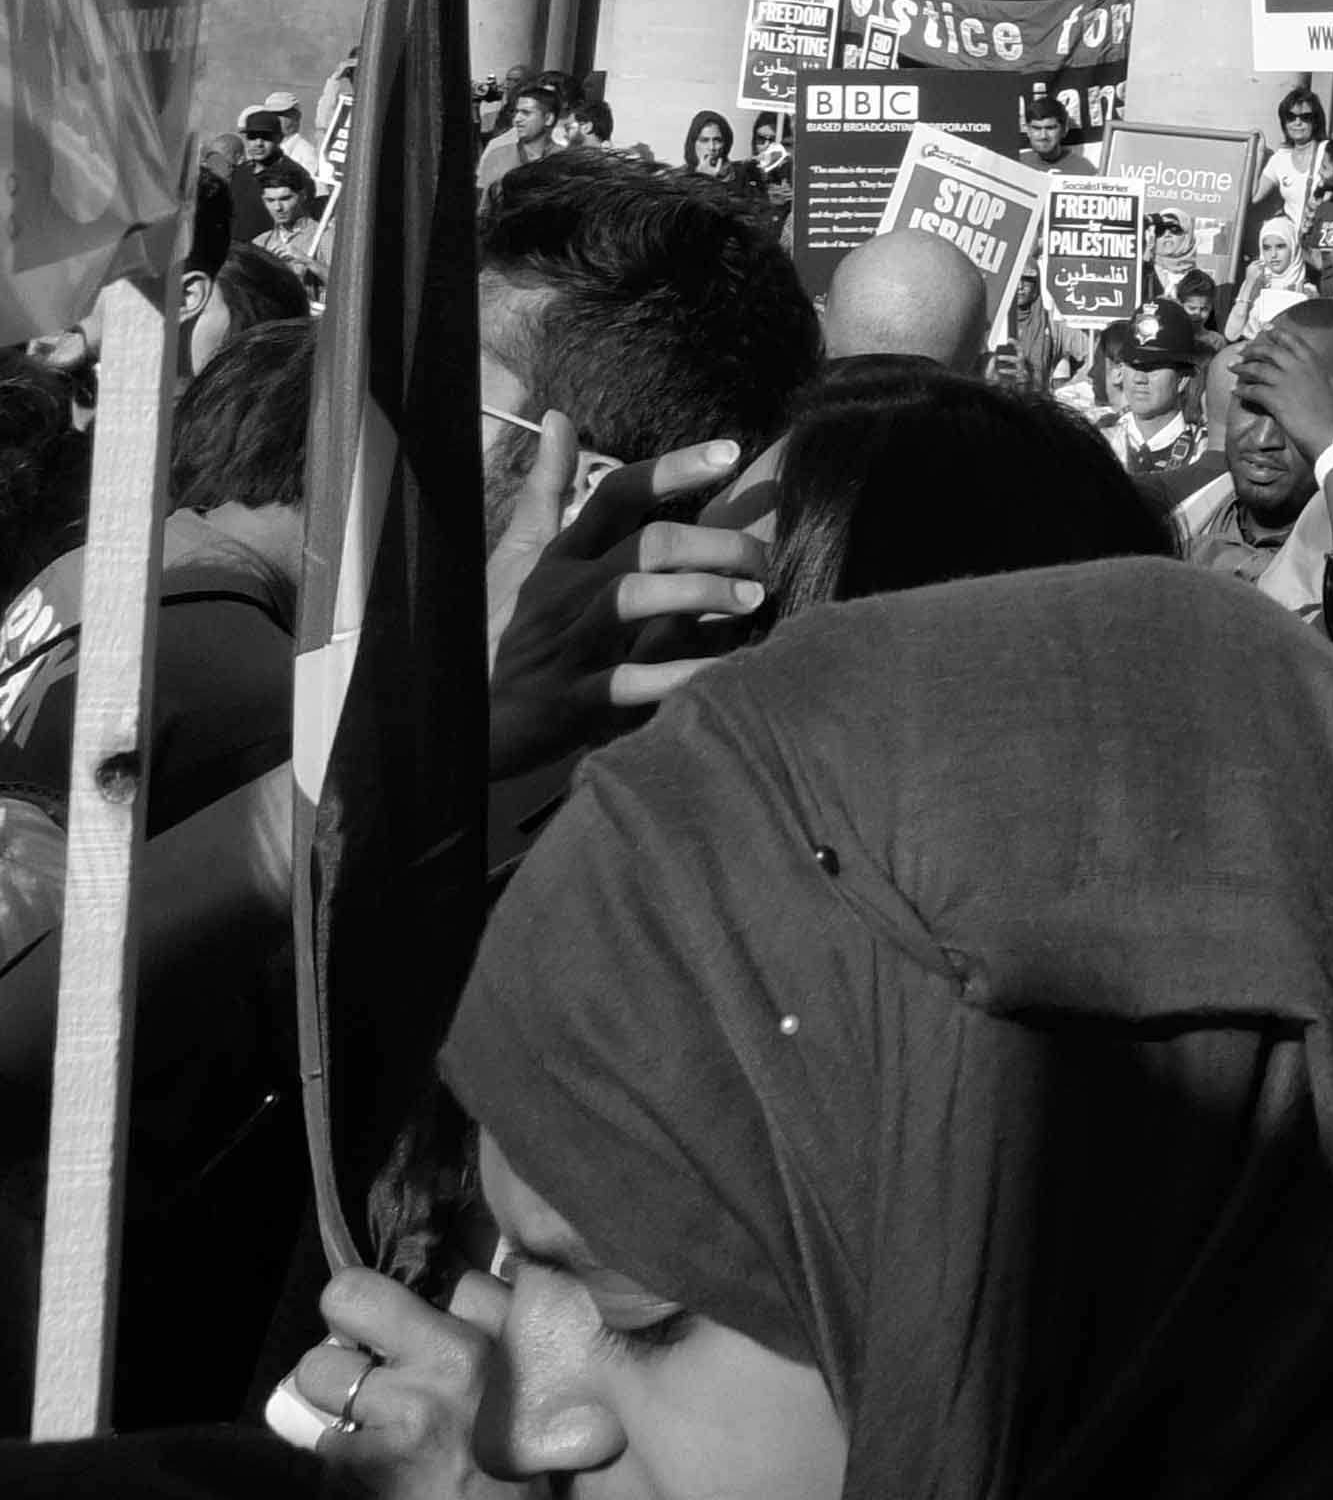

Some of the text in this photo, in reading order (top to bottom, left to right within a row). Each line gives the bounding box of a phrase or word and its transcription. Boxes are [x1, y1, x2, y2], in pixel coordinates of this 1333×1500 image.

[755, 1, 830, 28] FREEDOM
[750, 29, 829, 58] PALESTINE
[813, 89, 916, 118] BBC
[806, 122, 841, 133] BIASED
[843, 122, 916, 133] BROADCASTIN
[1120, 161, 1233, 192] welcome
[934, 178, 1006, 230] STOP
[1055, 194, 1132, 222] FREEDOM
[1049, 230, 1136, 258] PALESTINE
